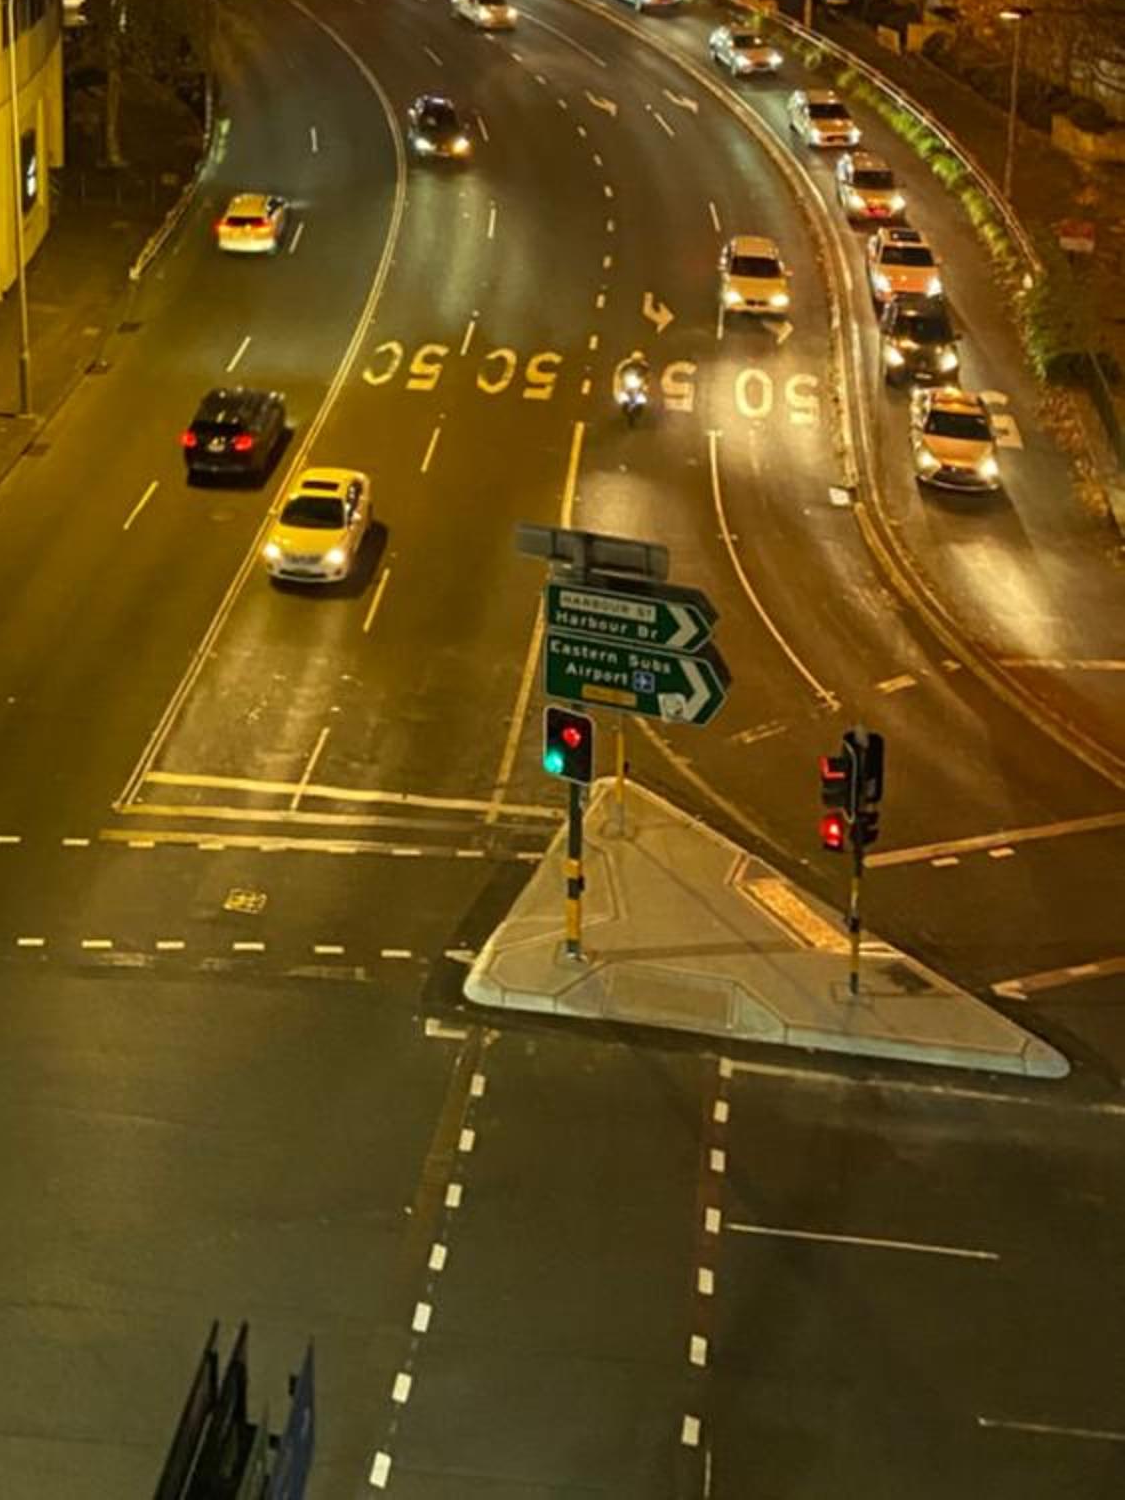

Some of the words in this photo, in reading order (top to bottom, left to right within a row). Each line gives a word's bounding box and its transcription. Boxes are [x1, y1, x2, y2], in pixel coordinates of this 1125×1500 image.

[734, 367, 821, 424] 50
[555, 610, 628, 634] Harbour
[550, 639, 618, 663] Eastern
[627, 654, 671, 674] Subs
[565, 662, 628, 686] Airport
